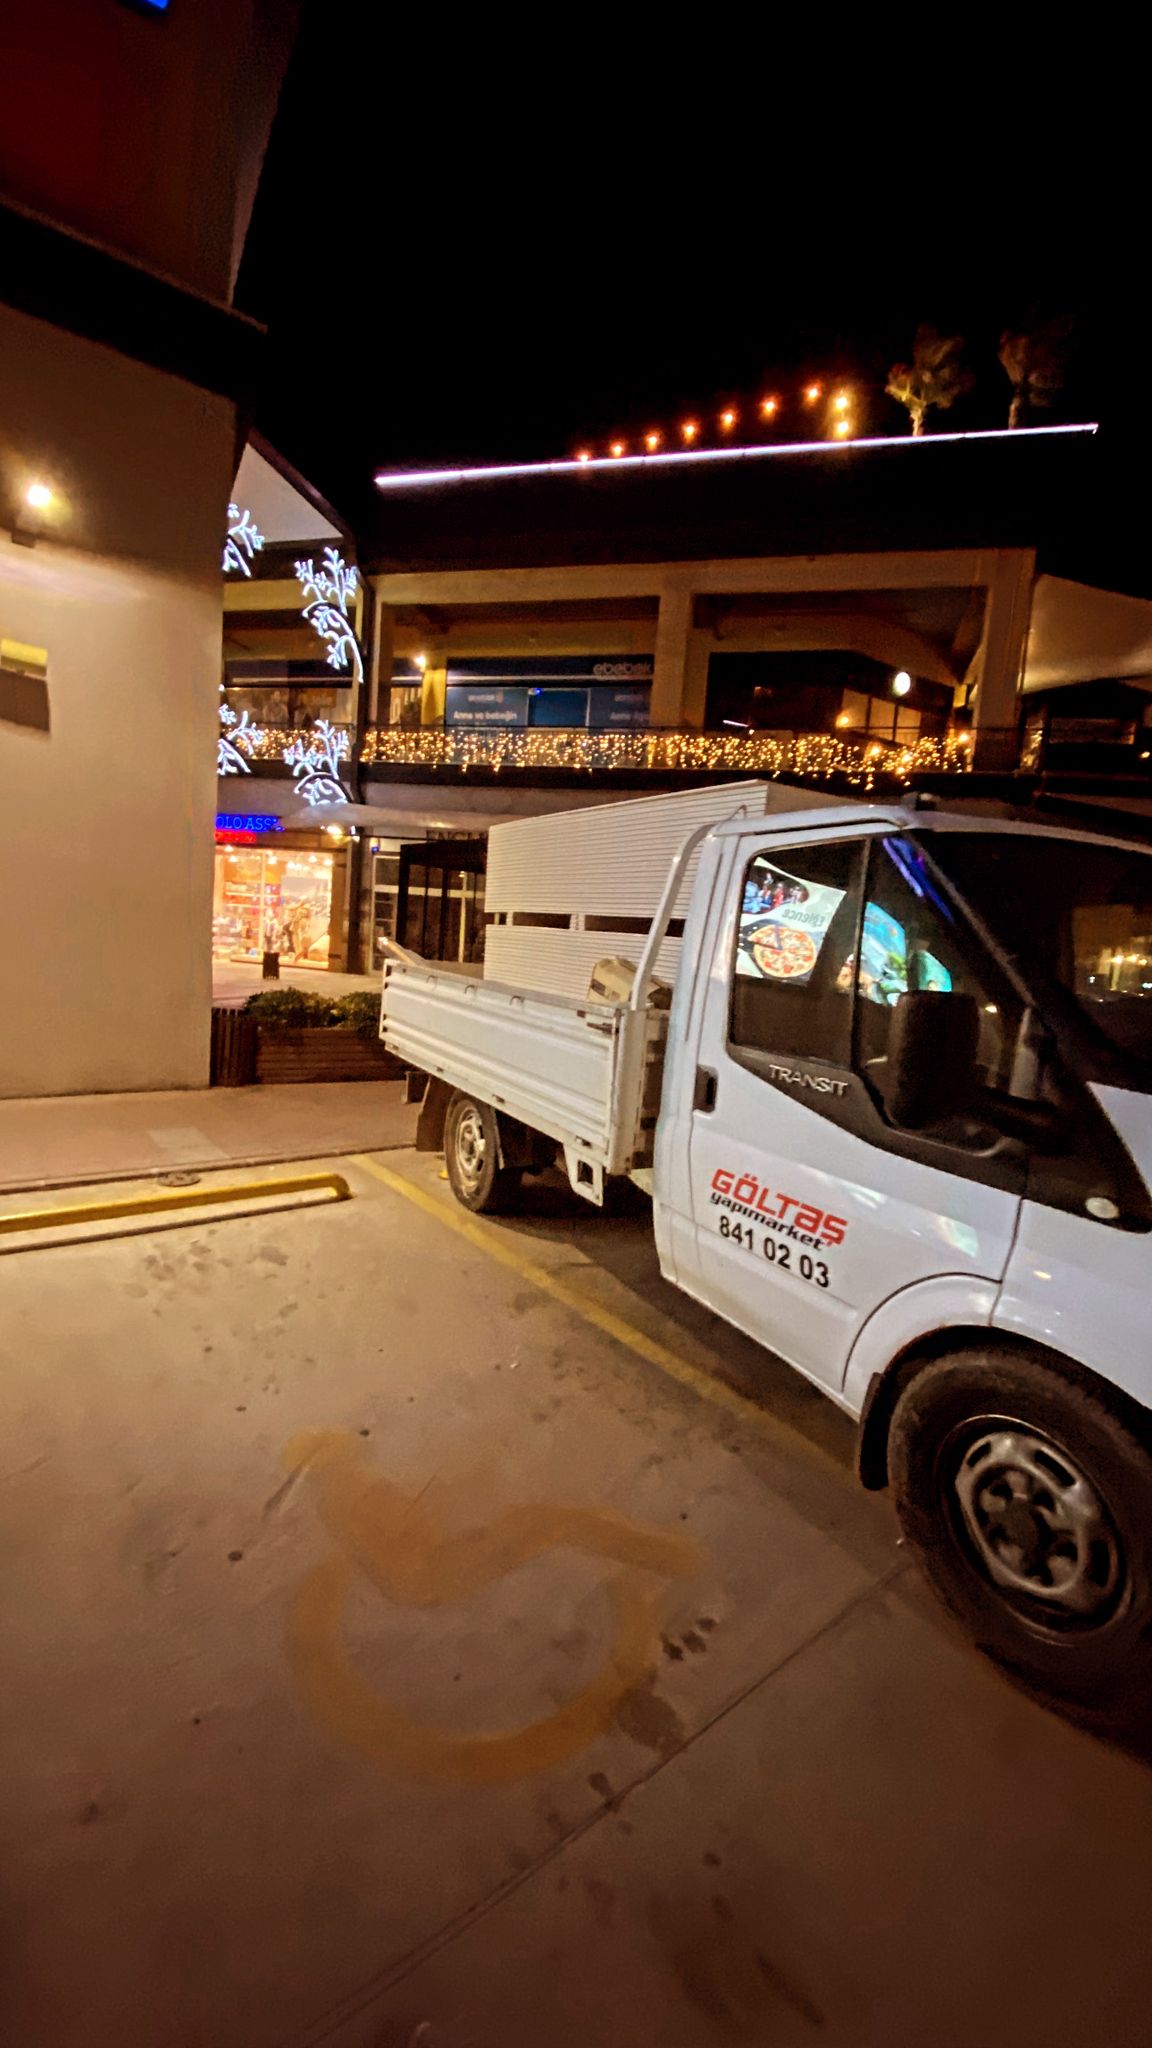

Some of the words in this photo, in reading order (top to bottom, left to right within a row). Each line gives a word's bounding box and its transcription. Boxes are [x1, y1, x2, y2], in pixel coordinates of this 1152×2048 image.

[769, 1064, 849, 1096] TRANSIT
[719, 1215, 754, 1251] 841
[763, 1237, 791, 1270] 02
[800, 1254, 830, 1289] 03
